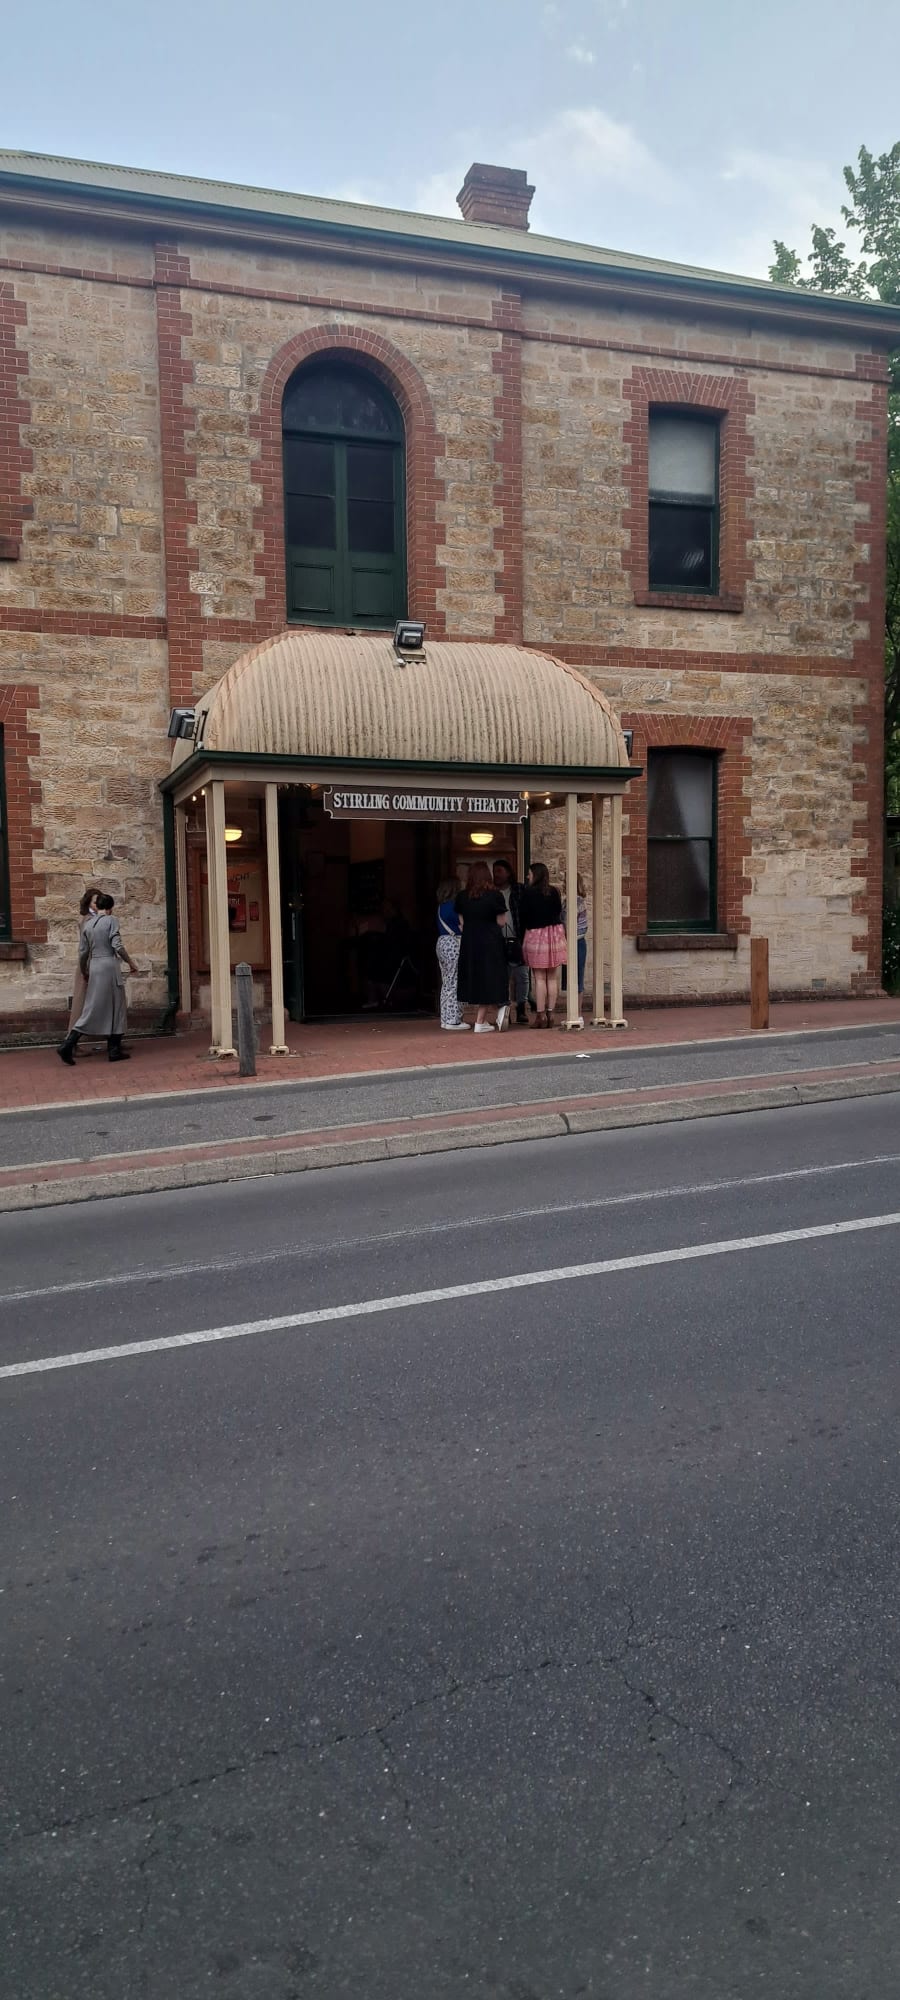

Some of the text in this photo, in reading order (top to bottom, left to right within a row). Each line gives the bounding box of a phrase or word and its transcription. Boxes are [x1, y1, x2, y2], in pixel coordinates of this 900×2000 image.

[333, 793, 520, 814] STIRLING COMMUNITY THEATRE
